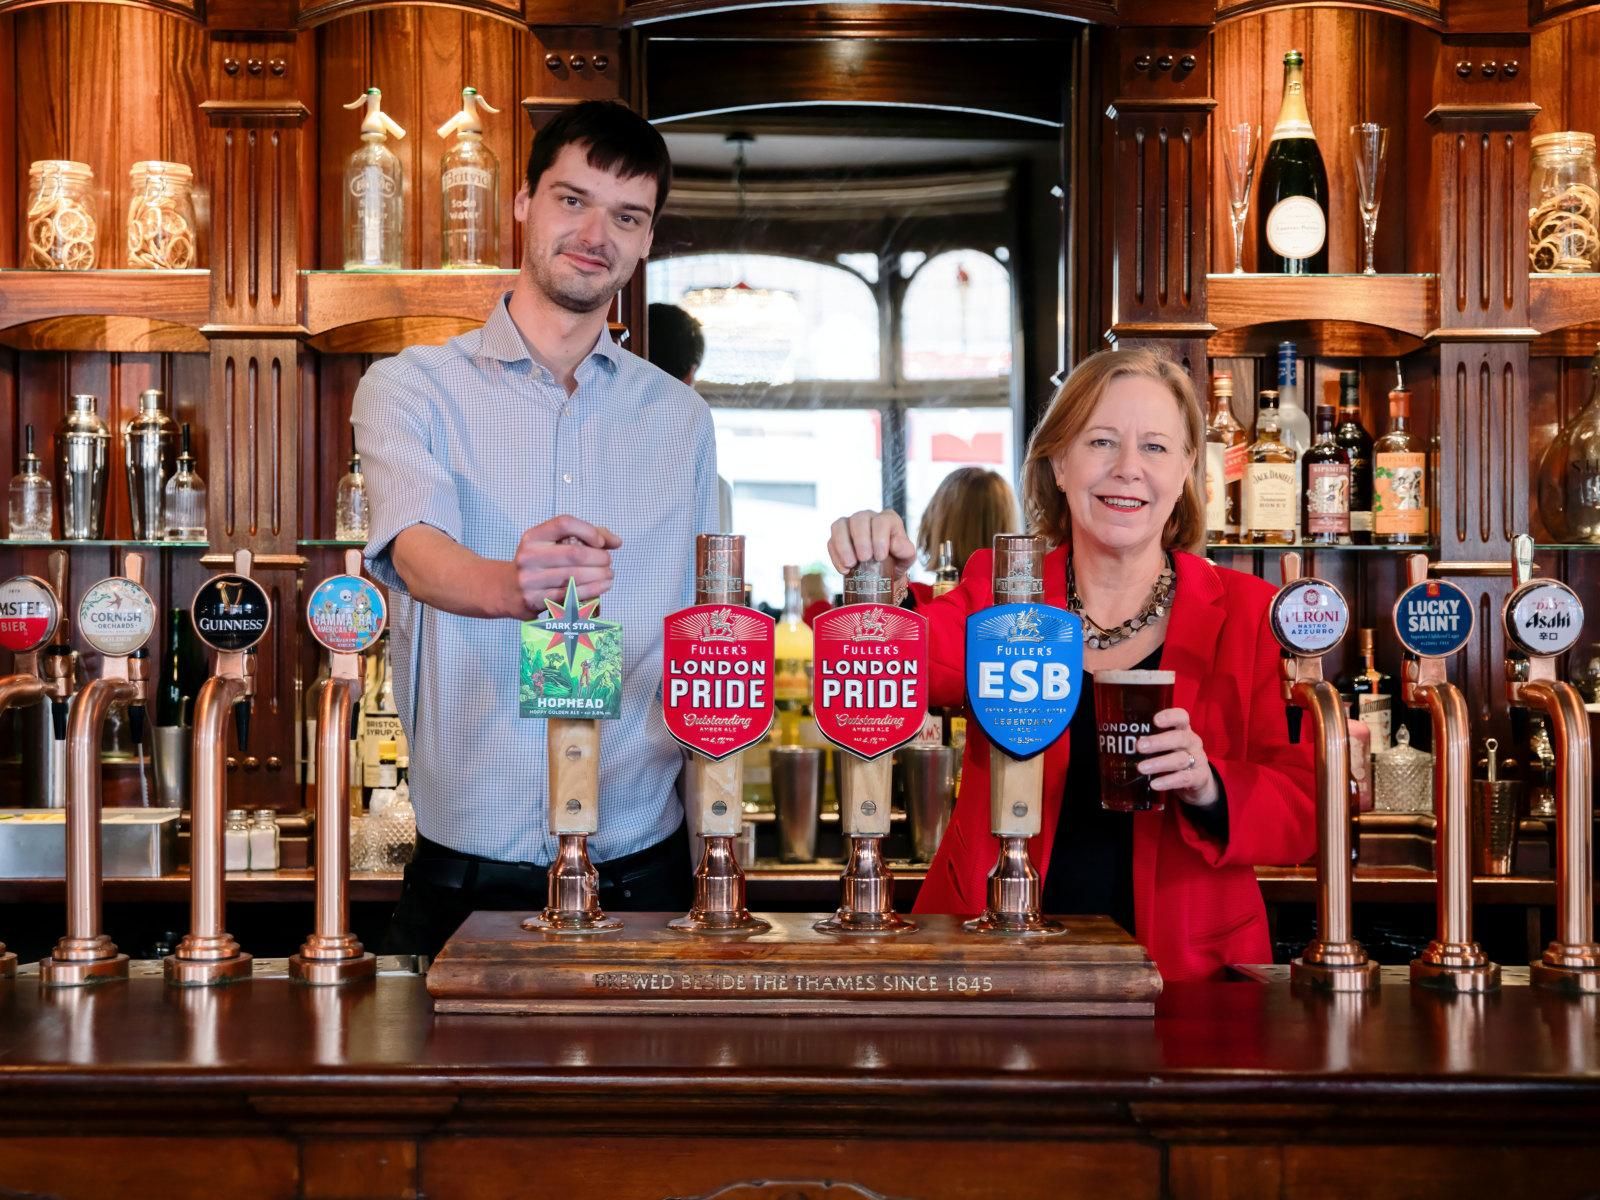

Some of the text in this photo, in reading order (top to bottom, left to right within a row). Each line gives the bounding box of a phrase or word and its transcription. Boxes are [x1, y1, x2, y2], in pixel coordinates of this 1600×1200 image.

[0, 601, 45, 616] MSTEL
[1408, 600, 1460, 615] LUCKY
[91, 612, 142, 622] CORNISH
[314, 613, 353, 626] GAMMA
[1408, 615, 1460, 632] SAINT
[1525, 611, 1571, 629] Asahi
[1, 621, 27, 632] BIER
[200, 618, 263, 631] GUINNESS
[545, 622, 595, 630] DARK STAR
[1539, 632, 1558, 641] 辛口
[691, 644, 747, 656] FULLER'S
[843, 644, 899, 656] FULLER'S
[997, 645, 1052, 656] FULLER'S
[670, 660, 766, 675] LONDON
[822, 660, 918, 675] LONDON
[978, 659, 1071, 702] ESB
[670, 679, 765, 708] PRIDE
[822, 679, 918, 708] PRIDE
[537, 698, 604, 709] HOPHEAD
[366, 721, 400, 729] BRISTOL
[683, 713, 752, 729] Outstanding
[835, 713, 905, 730] Outstanding
[994, 718, 1054, 726] LEGENDARY
[366, 729, 392, 737] SYRUP
[1099, 723, 1150, 733] LONDON
[1100, 735, 1140, 754] PRID
[594, 974, 993, 992] BREWED BESIDE THE THAMES SINCE 1845
